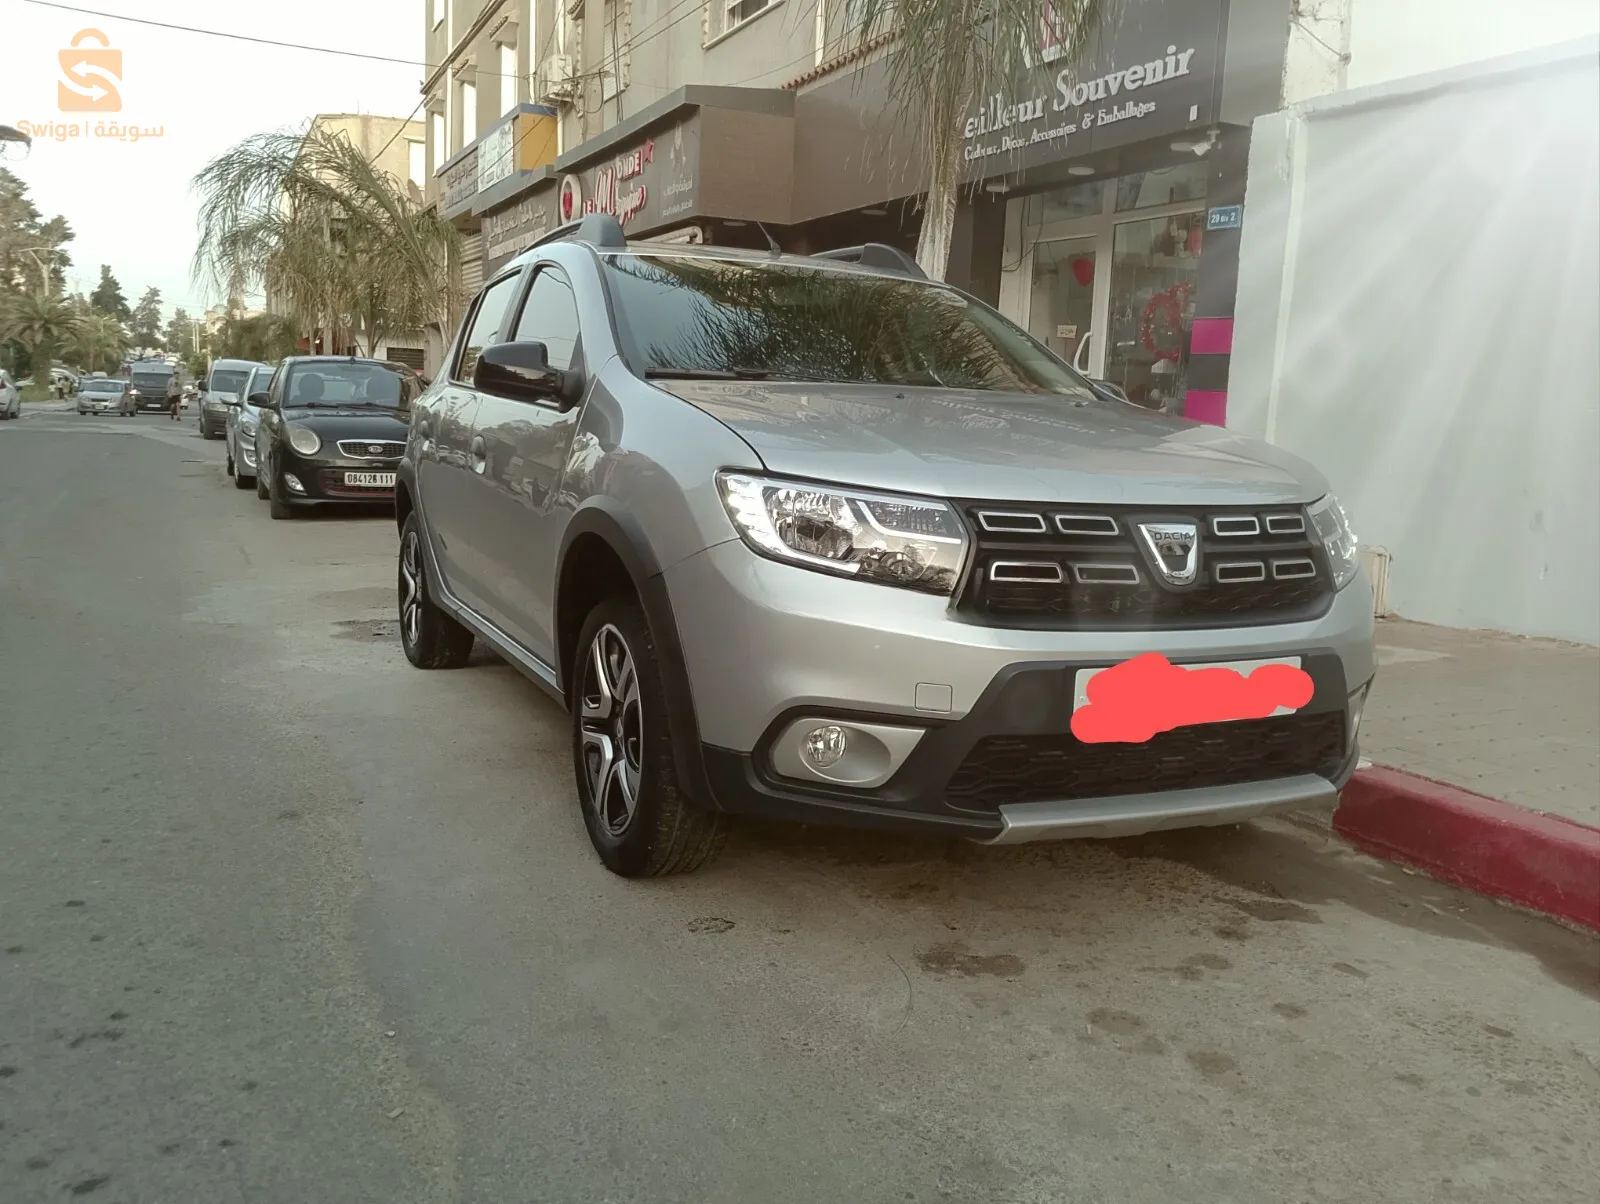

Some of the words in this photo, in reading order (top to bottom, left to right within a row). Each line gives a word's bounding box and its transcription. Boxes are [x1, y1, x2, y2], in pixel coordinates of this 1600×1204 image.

[963, 92, 1048, 139] eilleur
[1052, 45, 1195, 112] Souvenir
[1082, 112, 1095, 130] &
[1096, 101, 1156, 127] Emballages
[1210, 213, 1220, 224] 29
[1230, 211, 1237, 222] 2
[1154, 531, 1192, 541] DACIA
